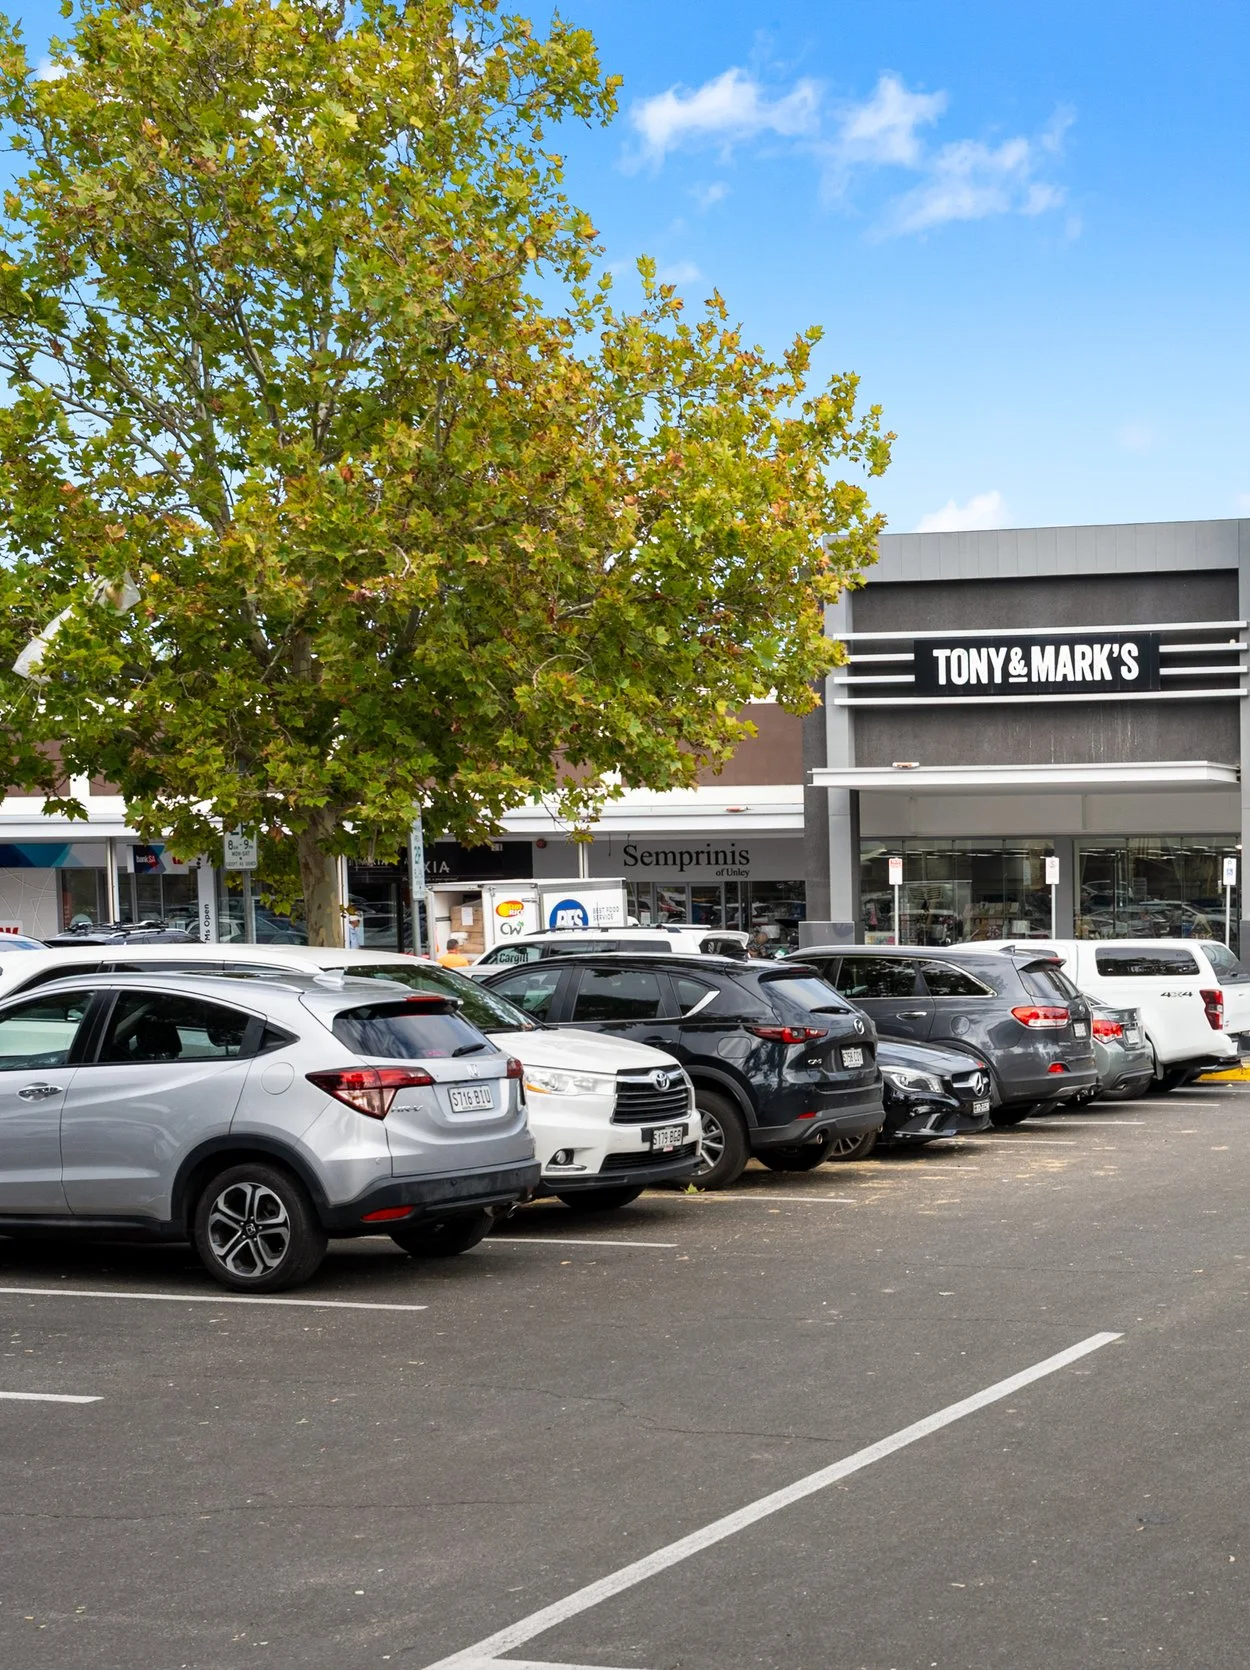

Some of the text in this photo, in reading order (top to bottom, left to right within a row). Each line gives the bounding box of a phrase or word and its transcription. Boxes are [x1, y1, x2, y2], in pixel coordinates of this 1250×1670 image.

[623, 843, 750, 872] Semprinis
[716, 868, 750, 878] of Unley
[500, 952, 528, 964] Cargill
